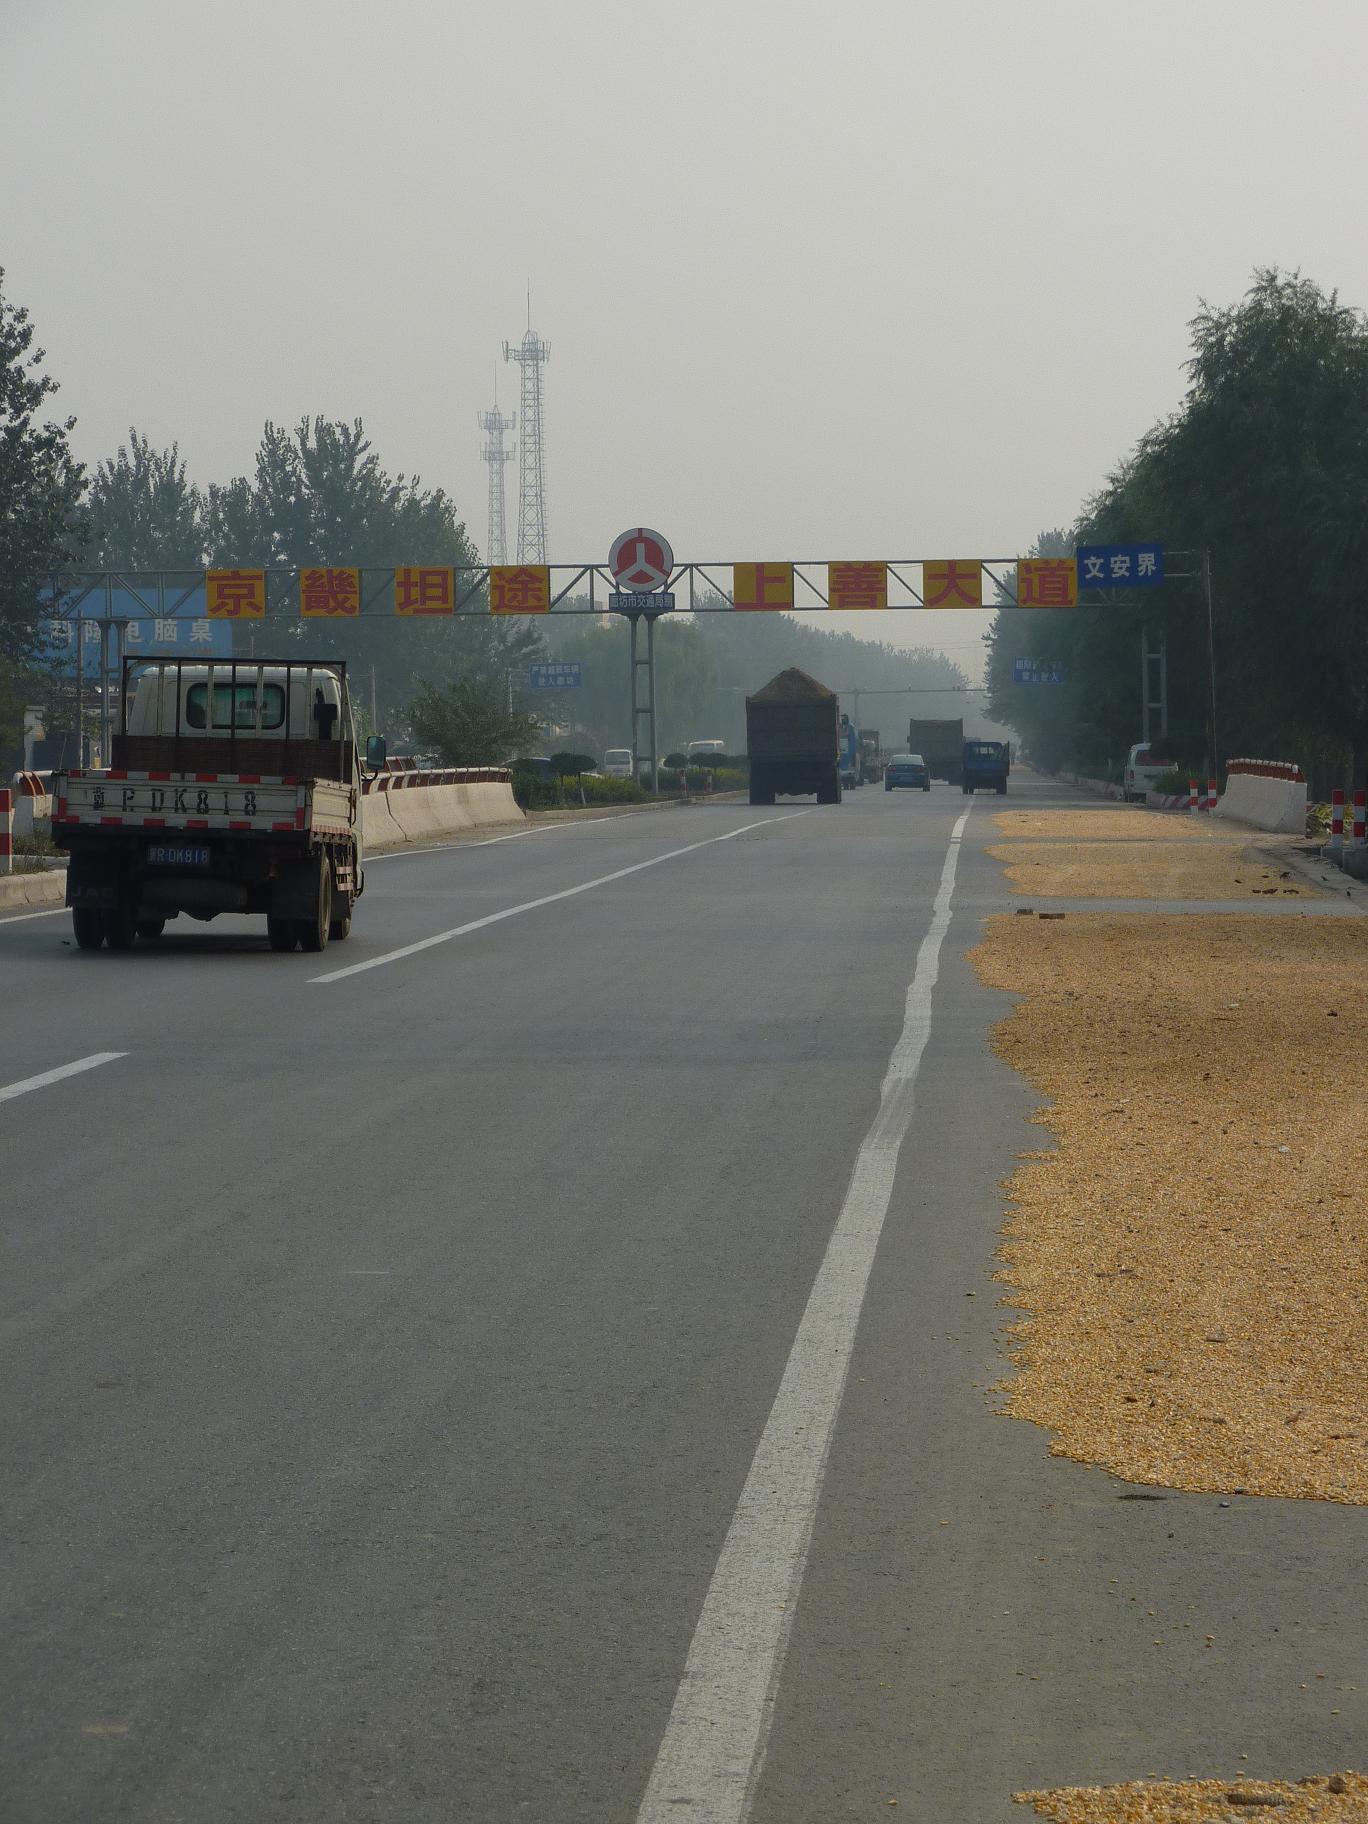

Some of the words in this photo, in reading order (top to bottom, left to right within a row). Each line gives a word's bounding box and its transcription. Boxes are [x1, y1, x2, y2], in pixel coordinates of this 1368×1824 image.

[734, 560, 1075, 609] 上善大道
[1083, 552, 1157, 580] 文安界
[207, 568, 547, 615] 京畿坦途
